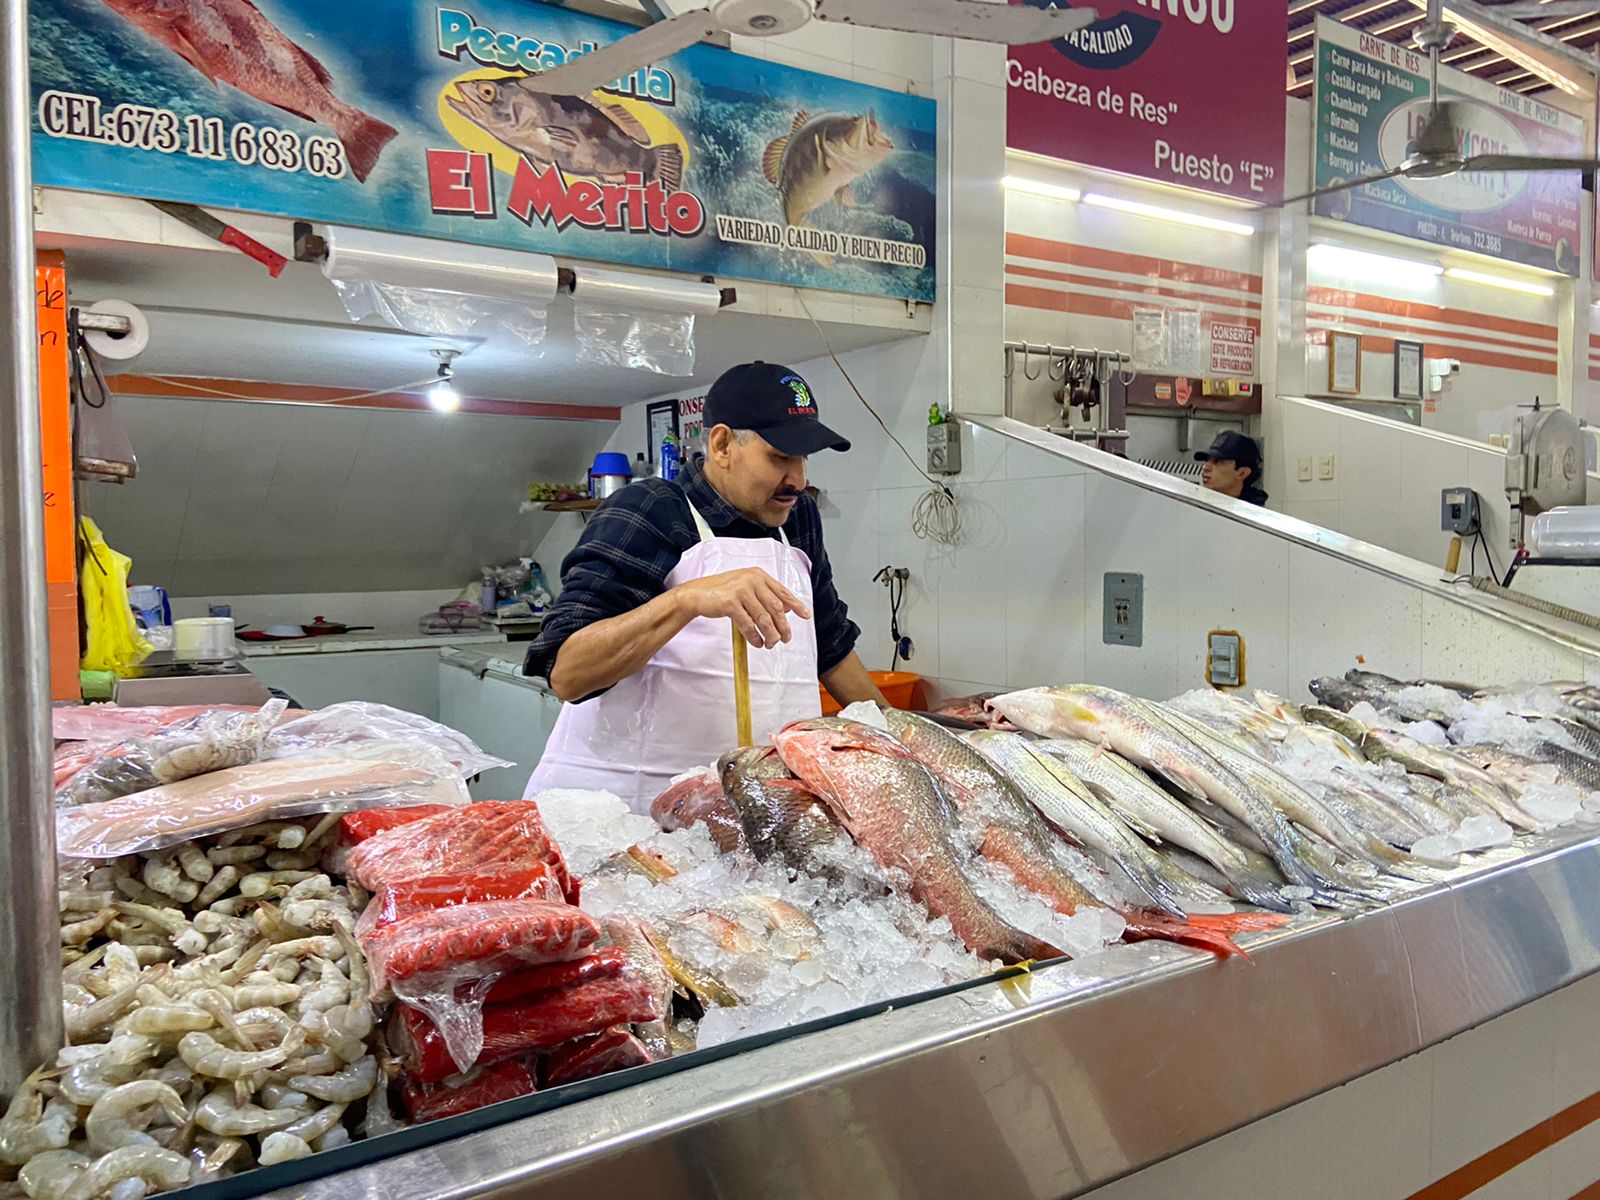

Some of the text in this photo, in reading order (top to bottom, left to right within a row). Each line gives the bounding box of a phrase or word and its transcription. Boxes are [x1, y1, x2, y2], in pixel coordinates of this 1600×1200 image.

[1080, 24, 1133, 54] CALIDAD
[1360, 34, 1421, 73] CARNE DE RES
[1331, 49, 1351, 70] Carne
[1006, 59, 1178, 125] Cabeza de Res"
[1499, 90, 1520, 112] CARNE
[1523, 100, 1532, 117] DE
[41, 91, 344, 177] CEL:673 11 6 83 63
[1329, 132, 1358, 153] Machaca
[1155, 139, 1234, 185] Puesto
[427, 148, 704, 234] El Merito
[718, 217, 926, 266] VARIEDAD, CALIDAD Y BUEN PRECIO
[1213, 325, 1253, 343] CONSERVE
